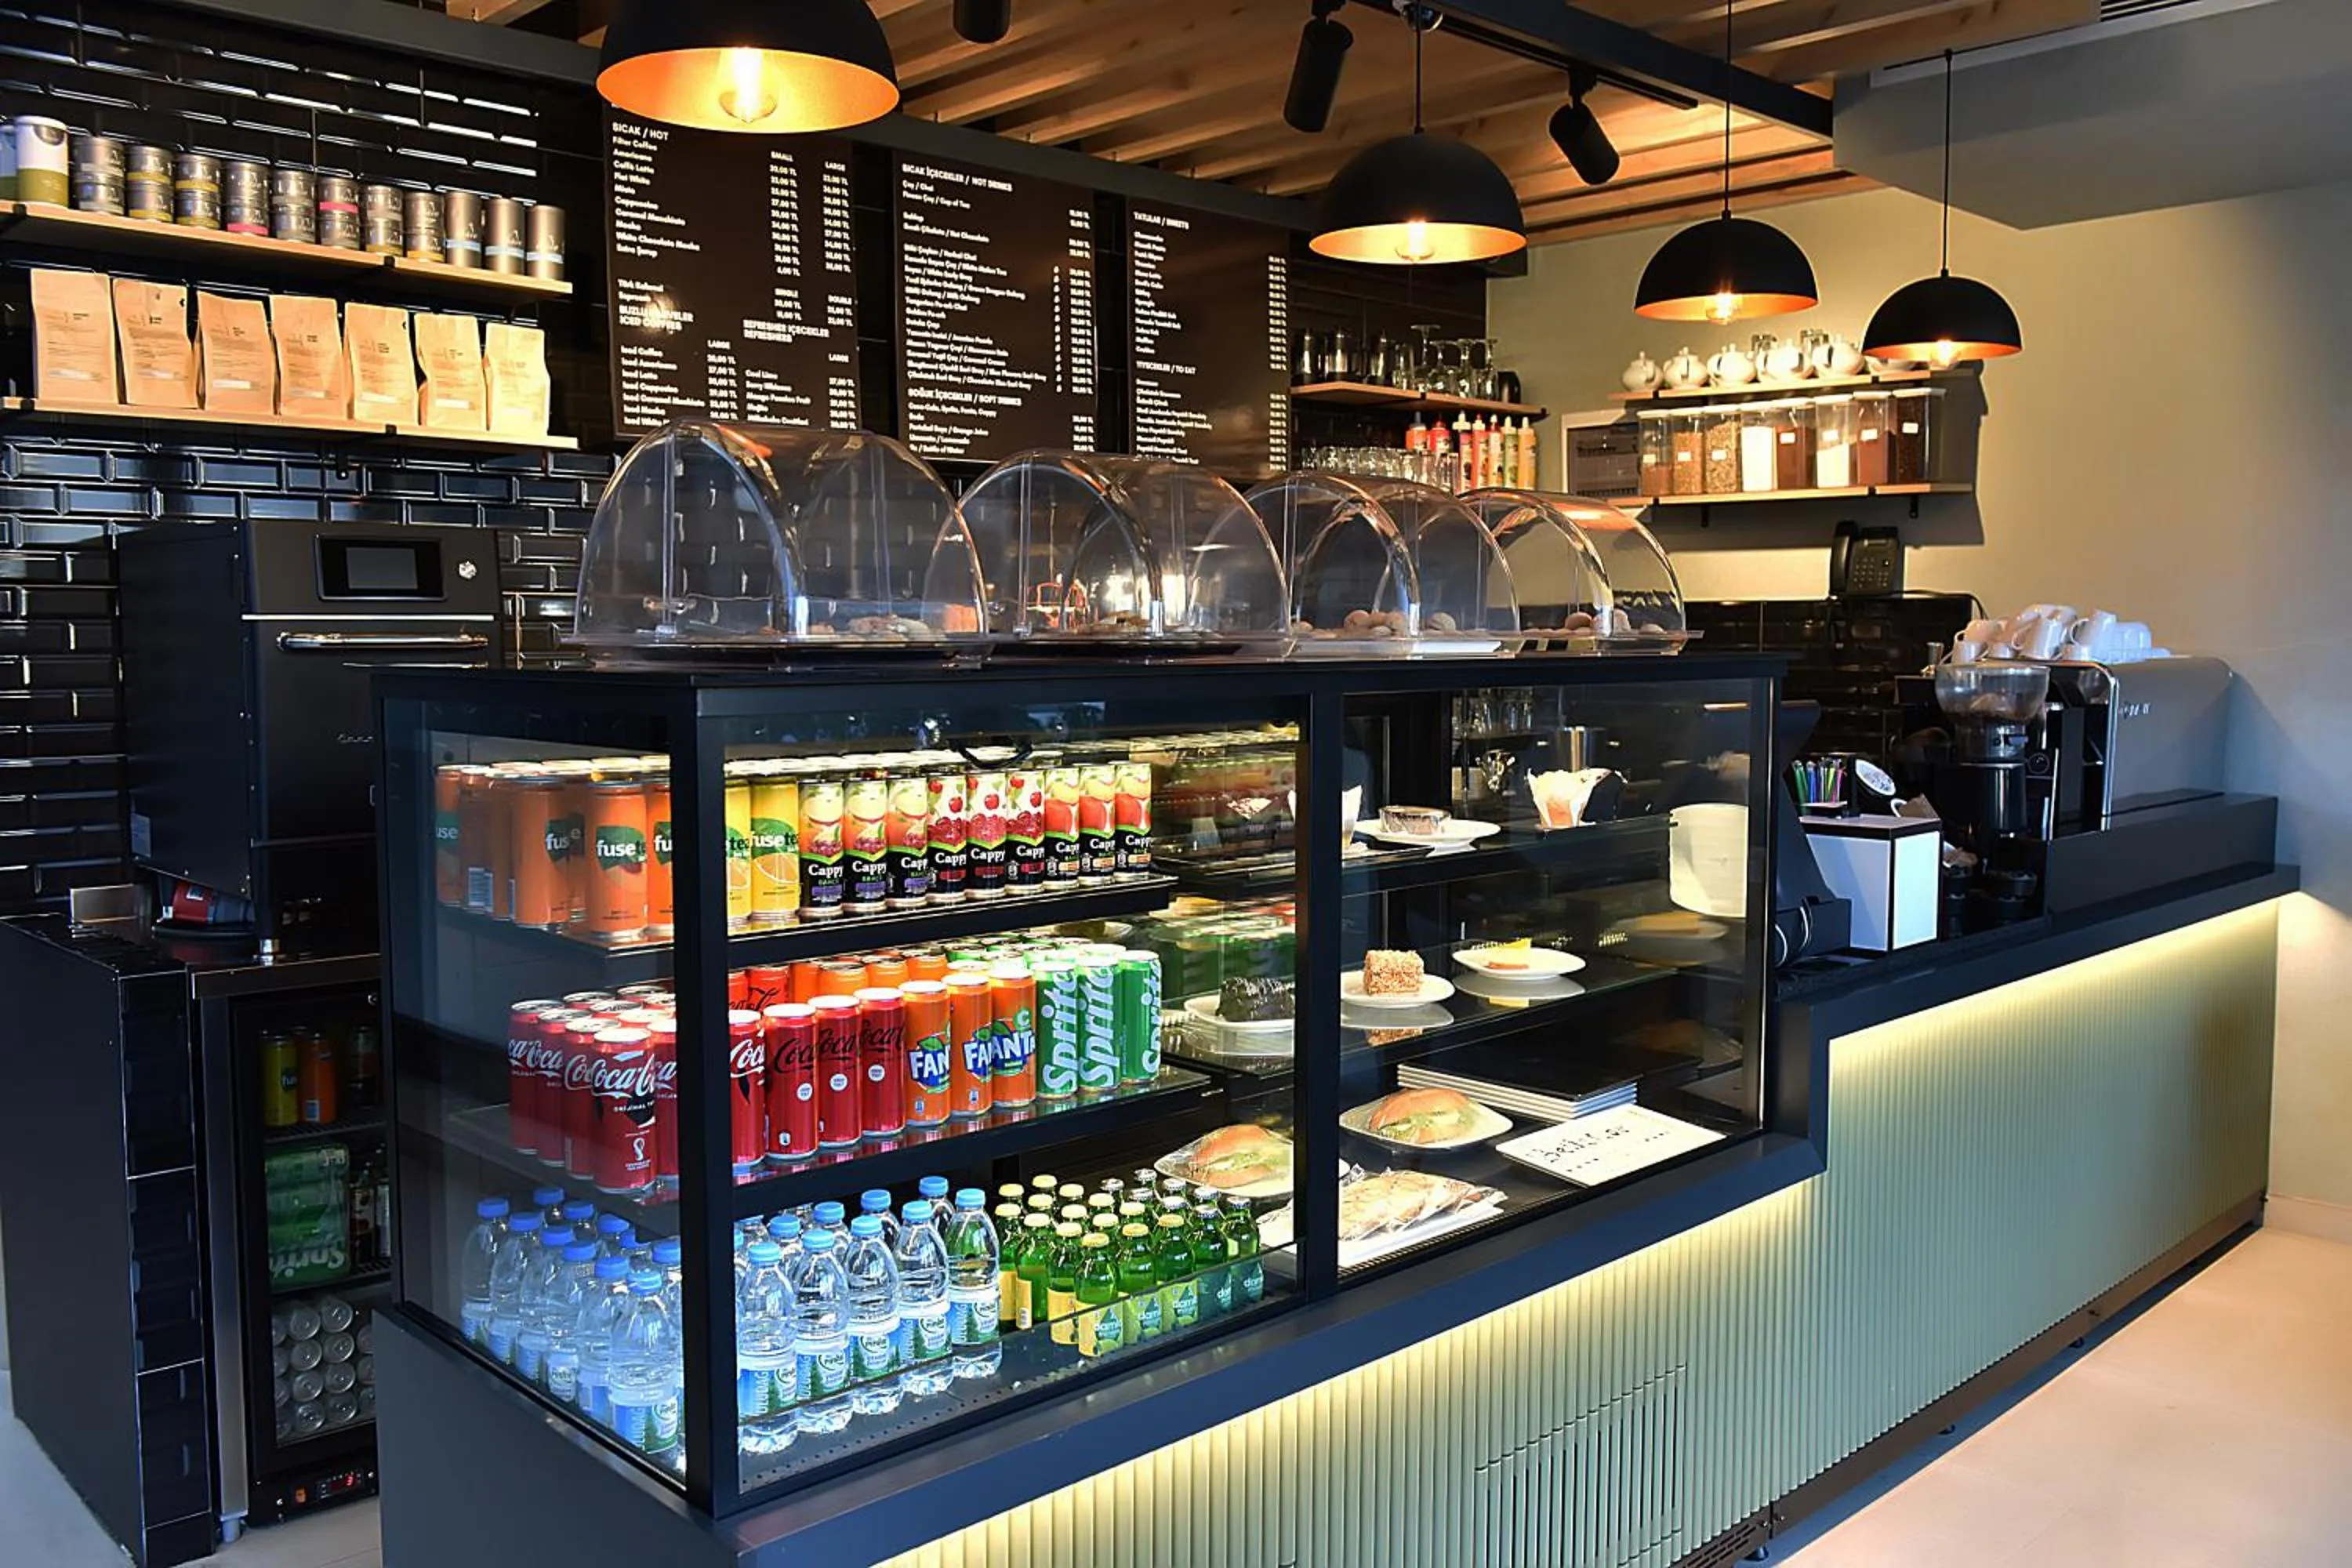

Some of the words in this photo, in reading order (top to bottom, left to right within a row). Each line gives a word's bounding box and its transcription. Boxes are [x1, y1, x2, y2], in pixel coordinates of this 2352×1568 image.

[613, 122, 641, 135] SICAK
[650, 129, 668, 140] HOT
[633, 140, 657, 151] Coffee
[826, 162, 845, 171] LARGE
[629, 175, 650, 185] White
[708, 340, 730, 350] LARGE
[829, 354, 848, 362] LARGE
[435, 826, 459, 839] use
[970, 848, 1006, 862] Cappy
[808, 863, 844, 877] Cappy
[852, 860, 887, 874] Cappy
[1044, 969, 1077, 1091] Sprite
[1079, 966, 1120, 1089] Sprite
